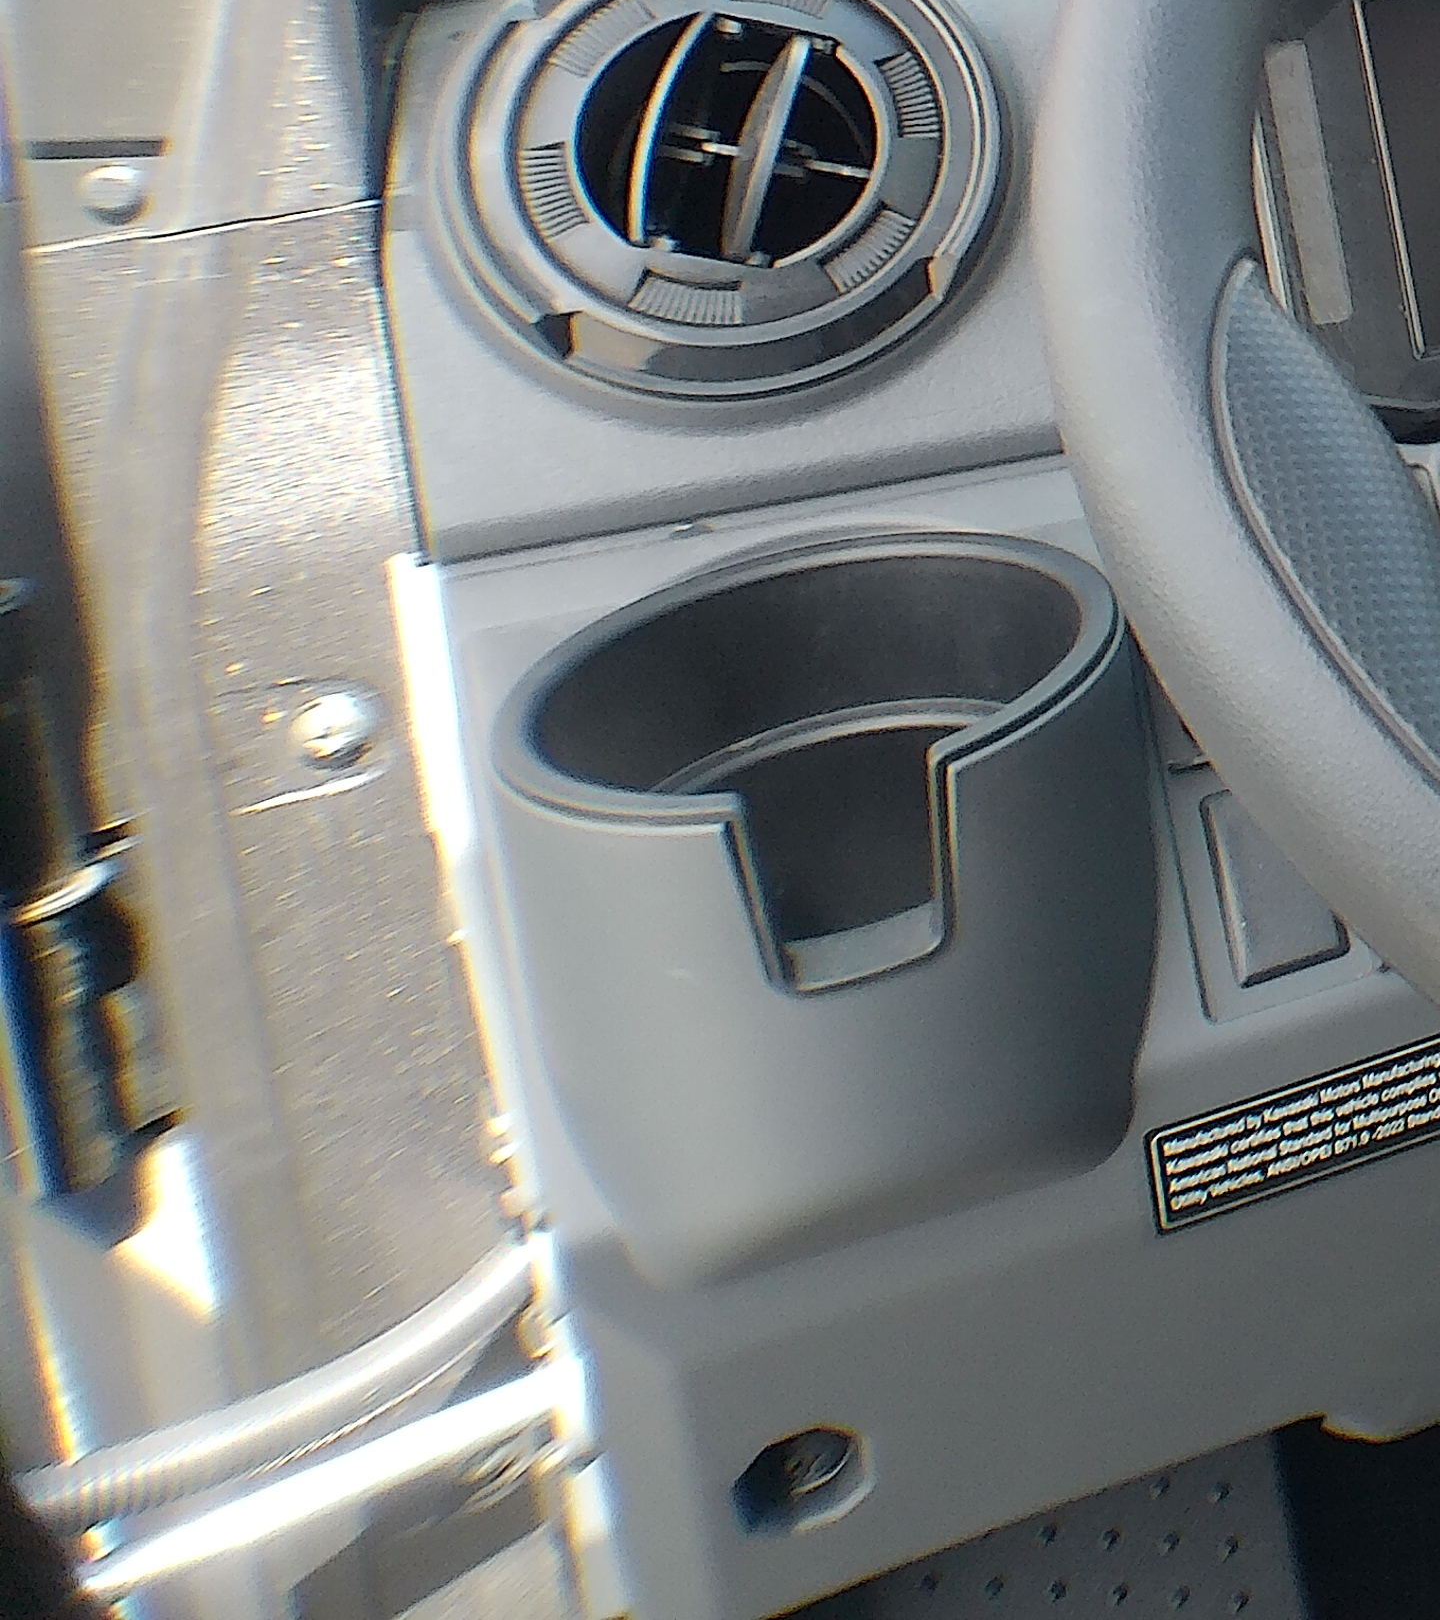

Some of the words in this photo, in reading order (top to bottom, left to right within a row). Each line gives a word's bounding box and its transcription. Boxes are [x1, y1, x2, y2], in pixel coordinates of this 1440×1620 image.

[1163, 1118, 1246, 1156] Manufactured
[1246, 1113, 1263, 1131] by
[1263, 1093, 1319, 1123] Kawasaki
[1319, 1079, 1361, 1104] Motors
[1361, 1051, 1440, 1090] Manufacturing
[1166, 1142, 1229, 1175] Kawasaki
[1282, 1115, 1309, 1136] that
[1309, 1108, 1334, 1127] this
[1335, 1092, 1379, 1116] vehicle
[1380, 1073, 1437, 1102] complies
[1169, 1163, 1227, 1194] American
[1227, 1144, 1278, 1174] National
[1279, 1125, 1333, 1156] Standard
[1334, 1121, 1351, 1137] for
[1352, 1094, 1428, 1131] Multipurpose
[1170, 1188, 1209, 1212] Utility
